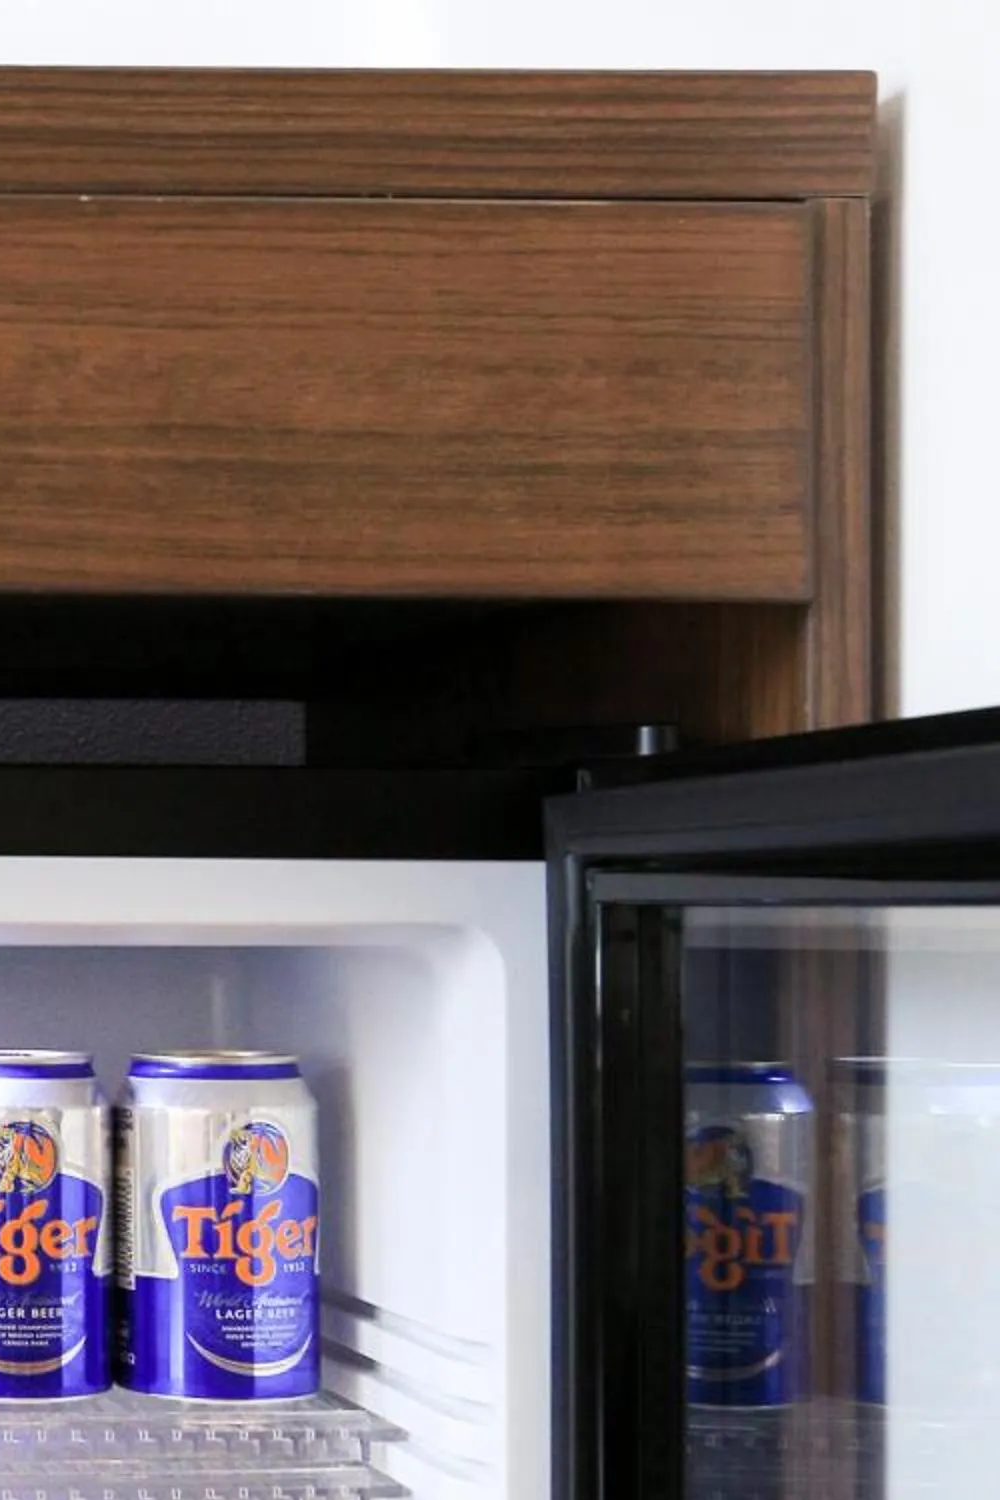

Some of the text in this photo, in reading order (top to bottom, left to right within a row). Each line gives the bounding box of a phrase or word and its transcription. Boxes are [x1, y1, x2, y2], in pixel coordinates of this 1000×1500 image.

[172, 1199, 318, 1286] Tiger
[189, 1263, 226, 1274] SINCE
[31, 1307, 66, 1319] BEER
[216, 1308, 263, 1320] LAGER
